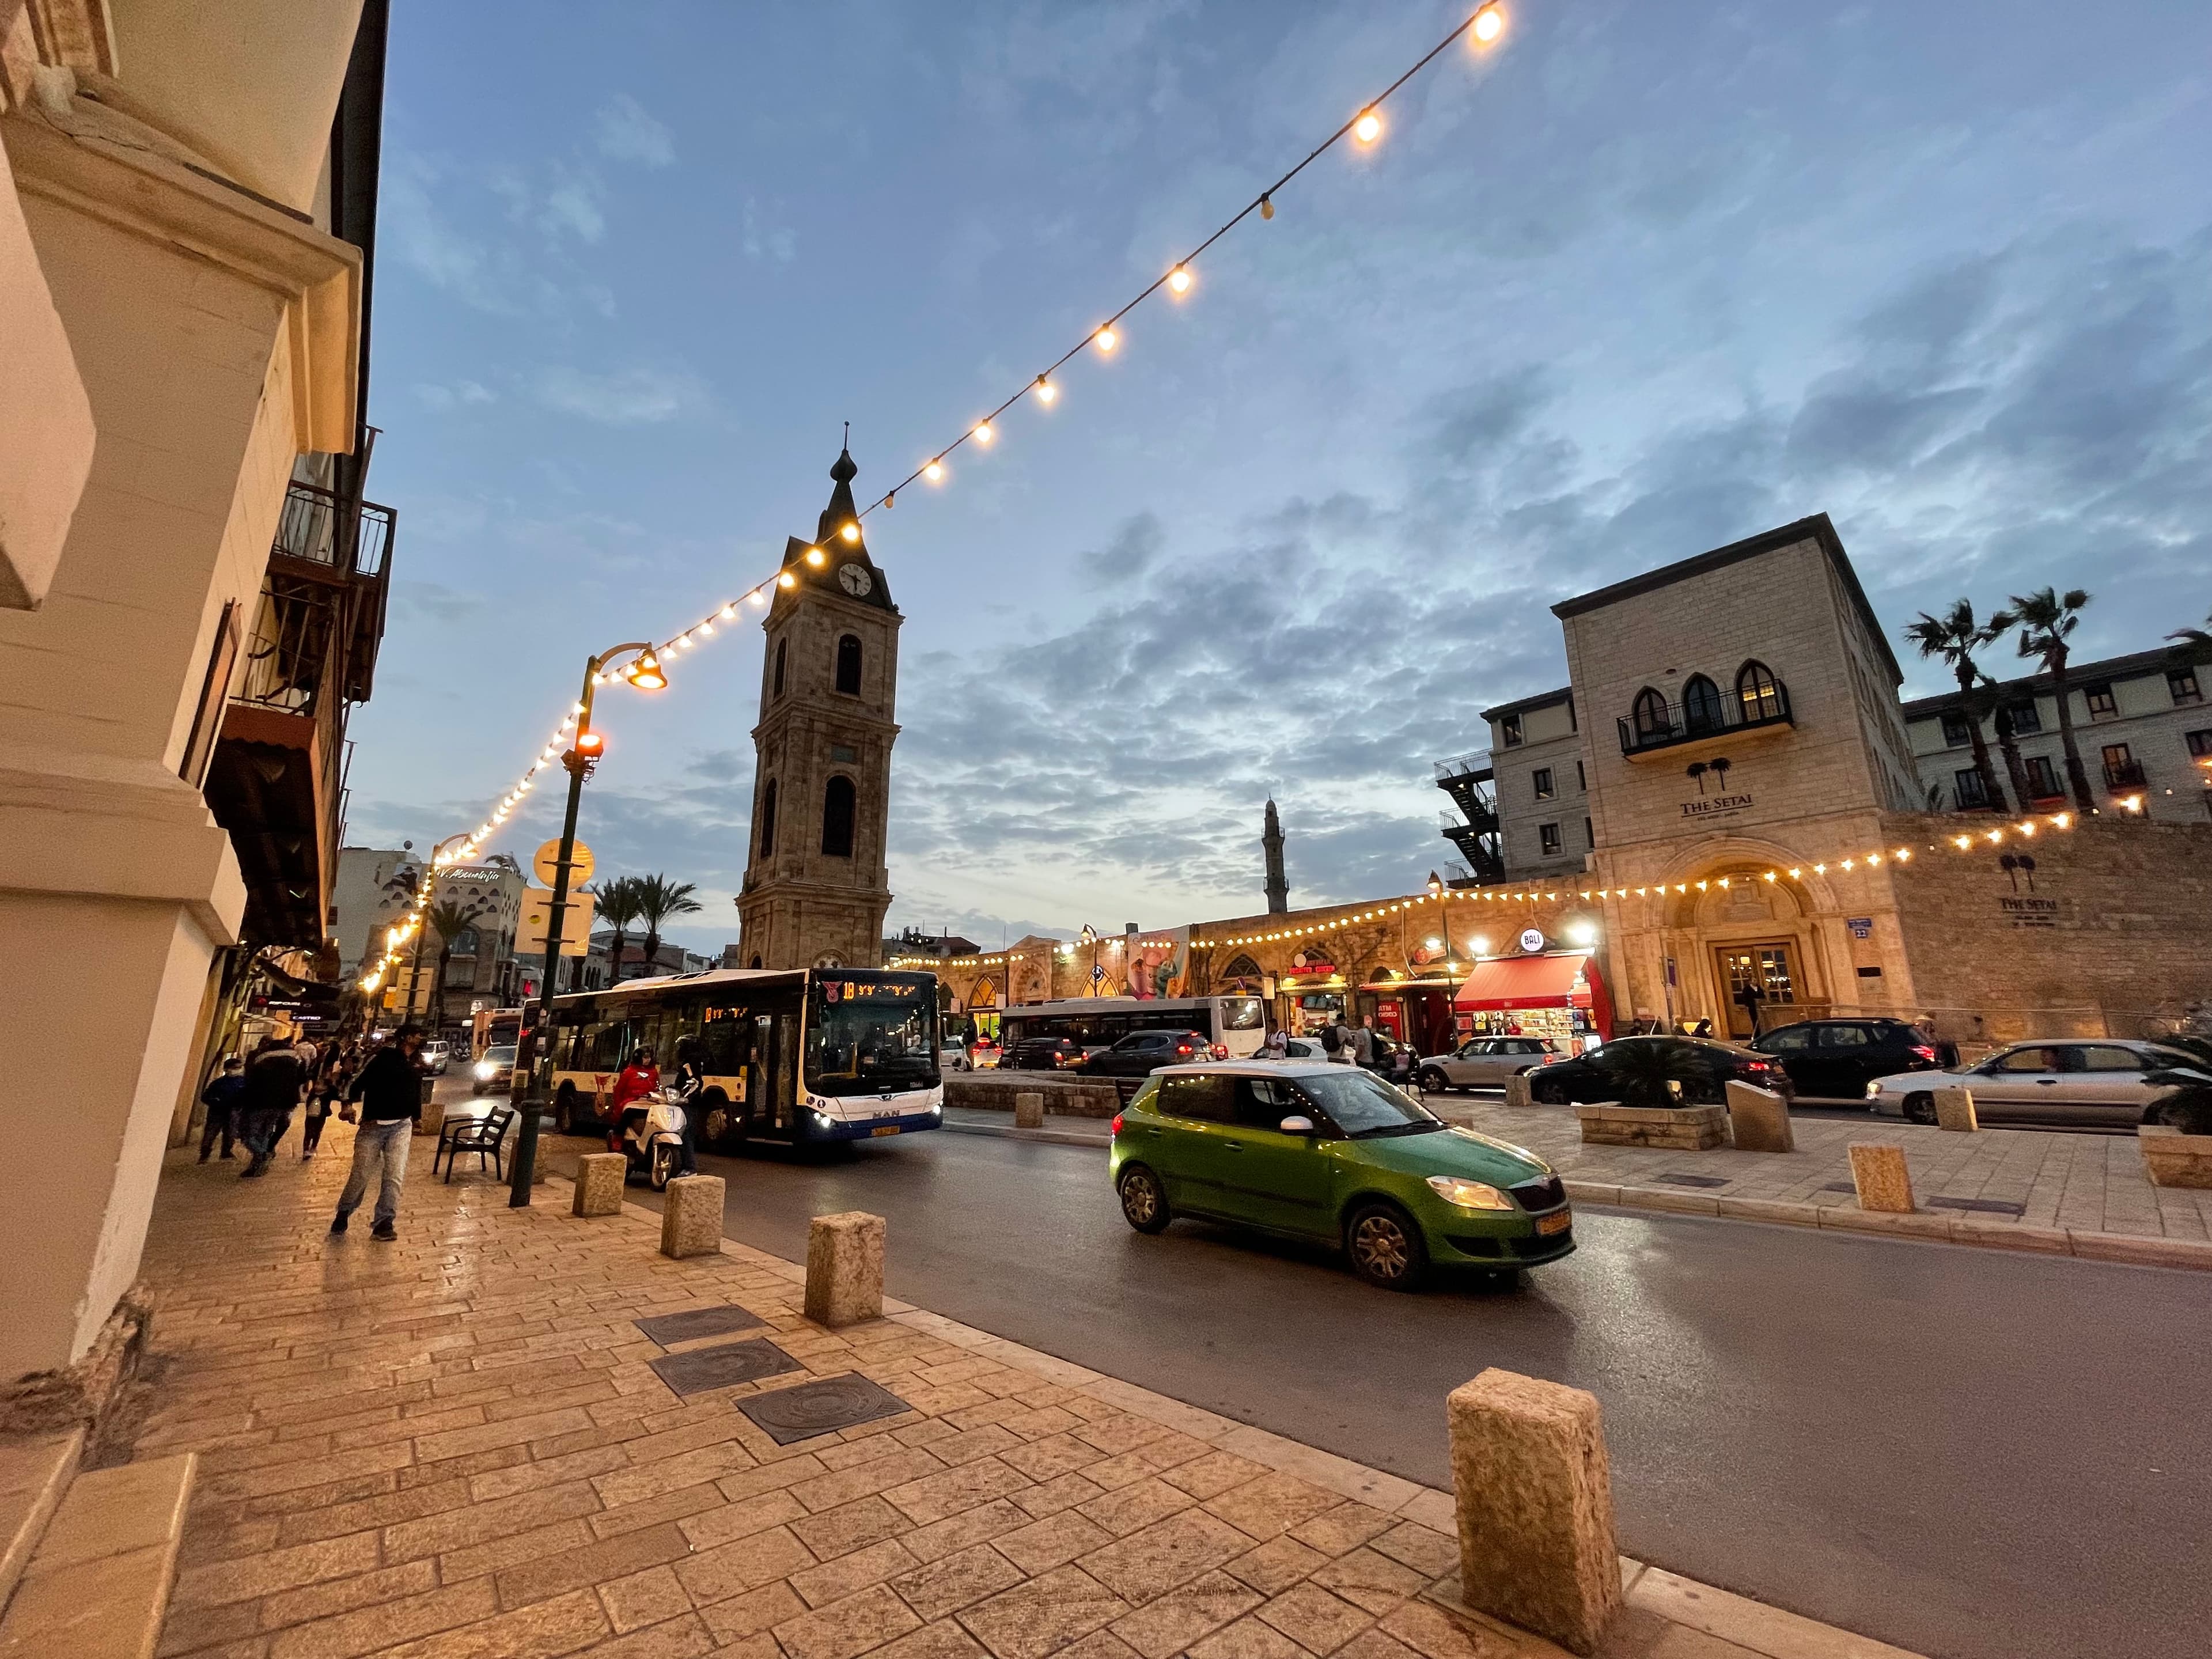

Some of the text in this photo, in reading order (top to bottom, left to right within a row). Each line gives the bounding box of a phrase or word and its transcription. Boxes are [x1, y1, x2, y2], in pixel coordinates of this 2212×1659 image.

[1680, 794, 1752, 814] THE SETAI
[2001, 897, 2025, 909] THE
[1524, 934, 1540, 945] BALI
[843, 982, 854, 999] 18
[872, 1109, 900, 1119] MAN
